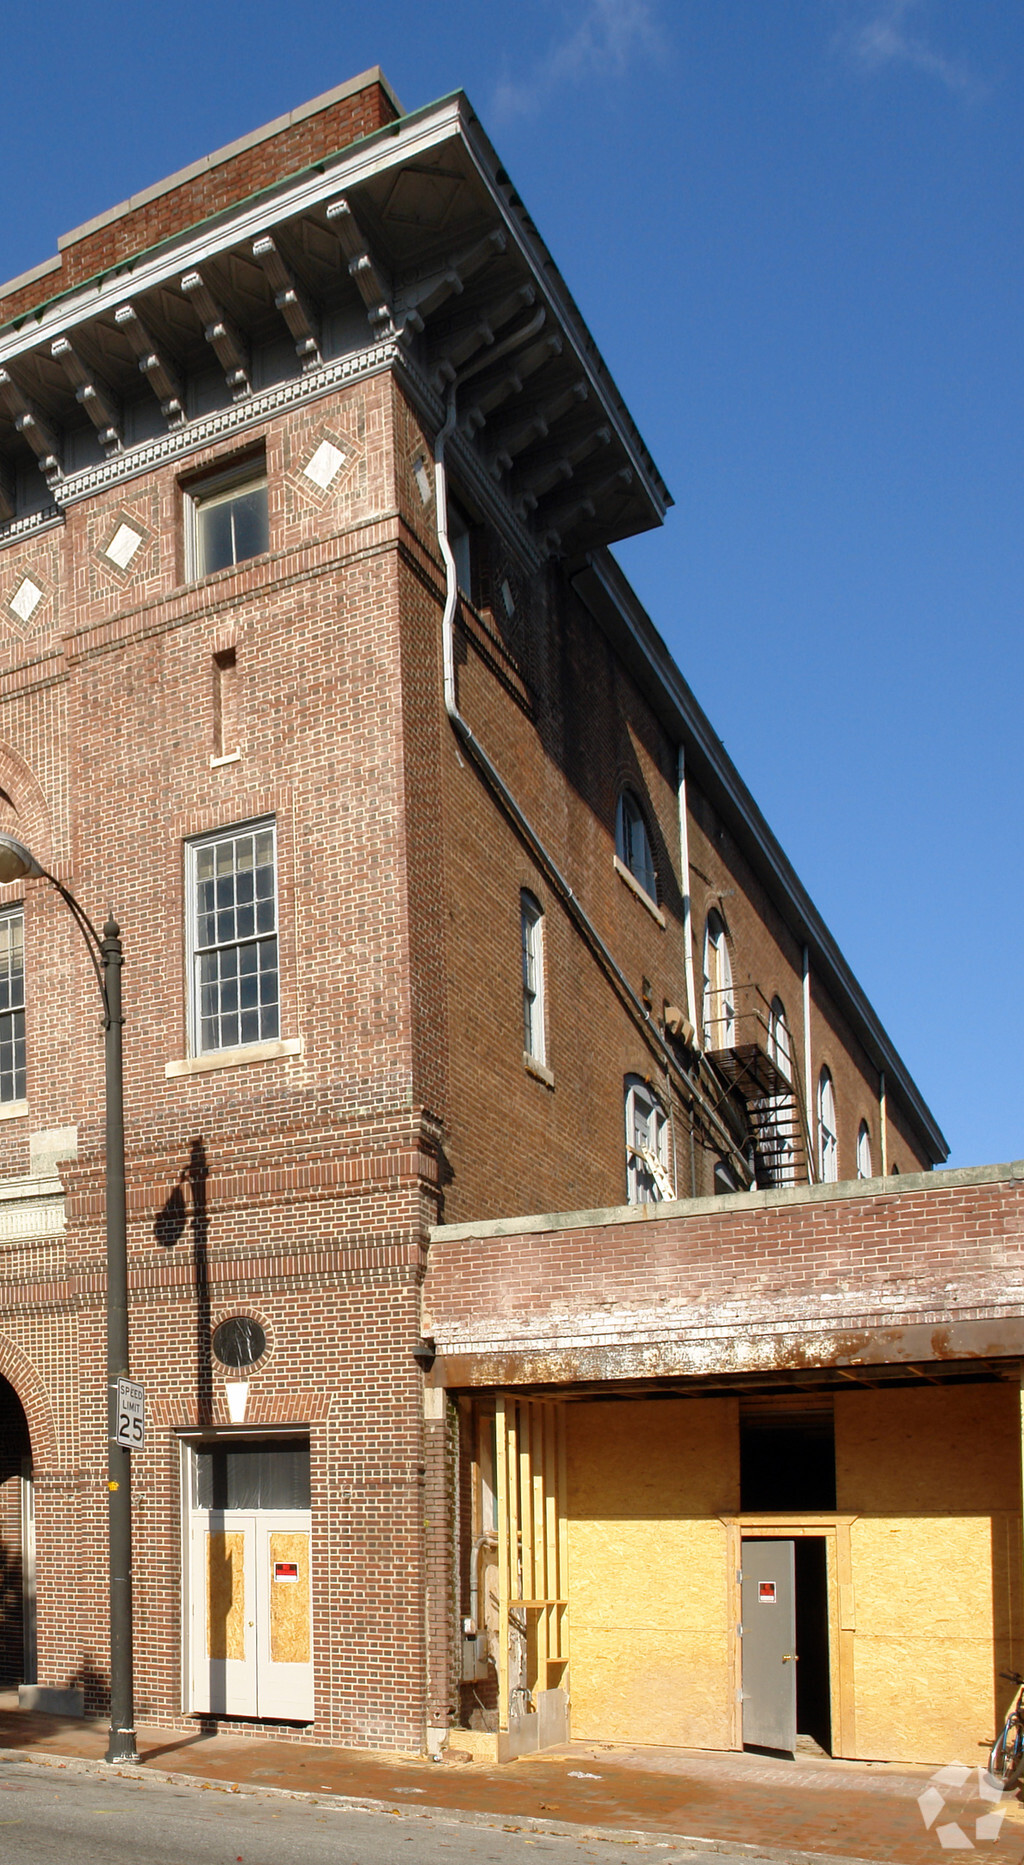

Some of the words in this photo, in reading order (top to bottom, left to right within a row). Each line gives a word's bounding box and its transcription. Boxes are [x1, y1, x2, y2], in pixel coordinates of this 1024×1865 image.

[120, 1385, 143, 1400] SPEED
[122, 1400, 140, 1413] LIMIT
[119, 1414, 143, 1441] 25
